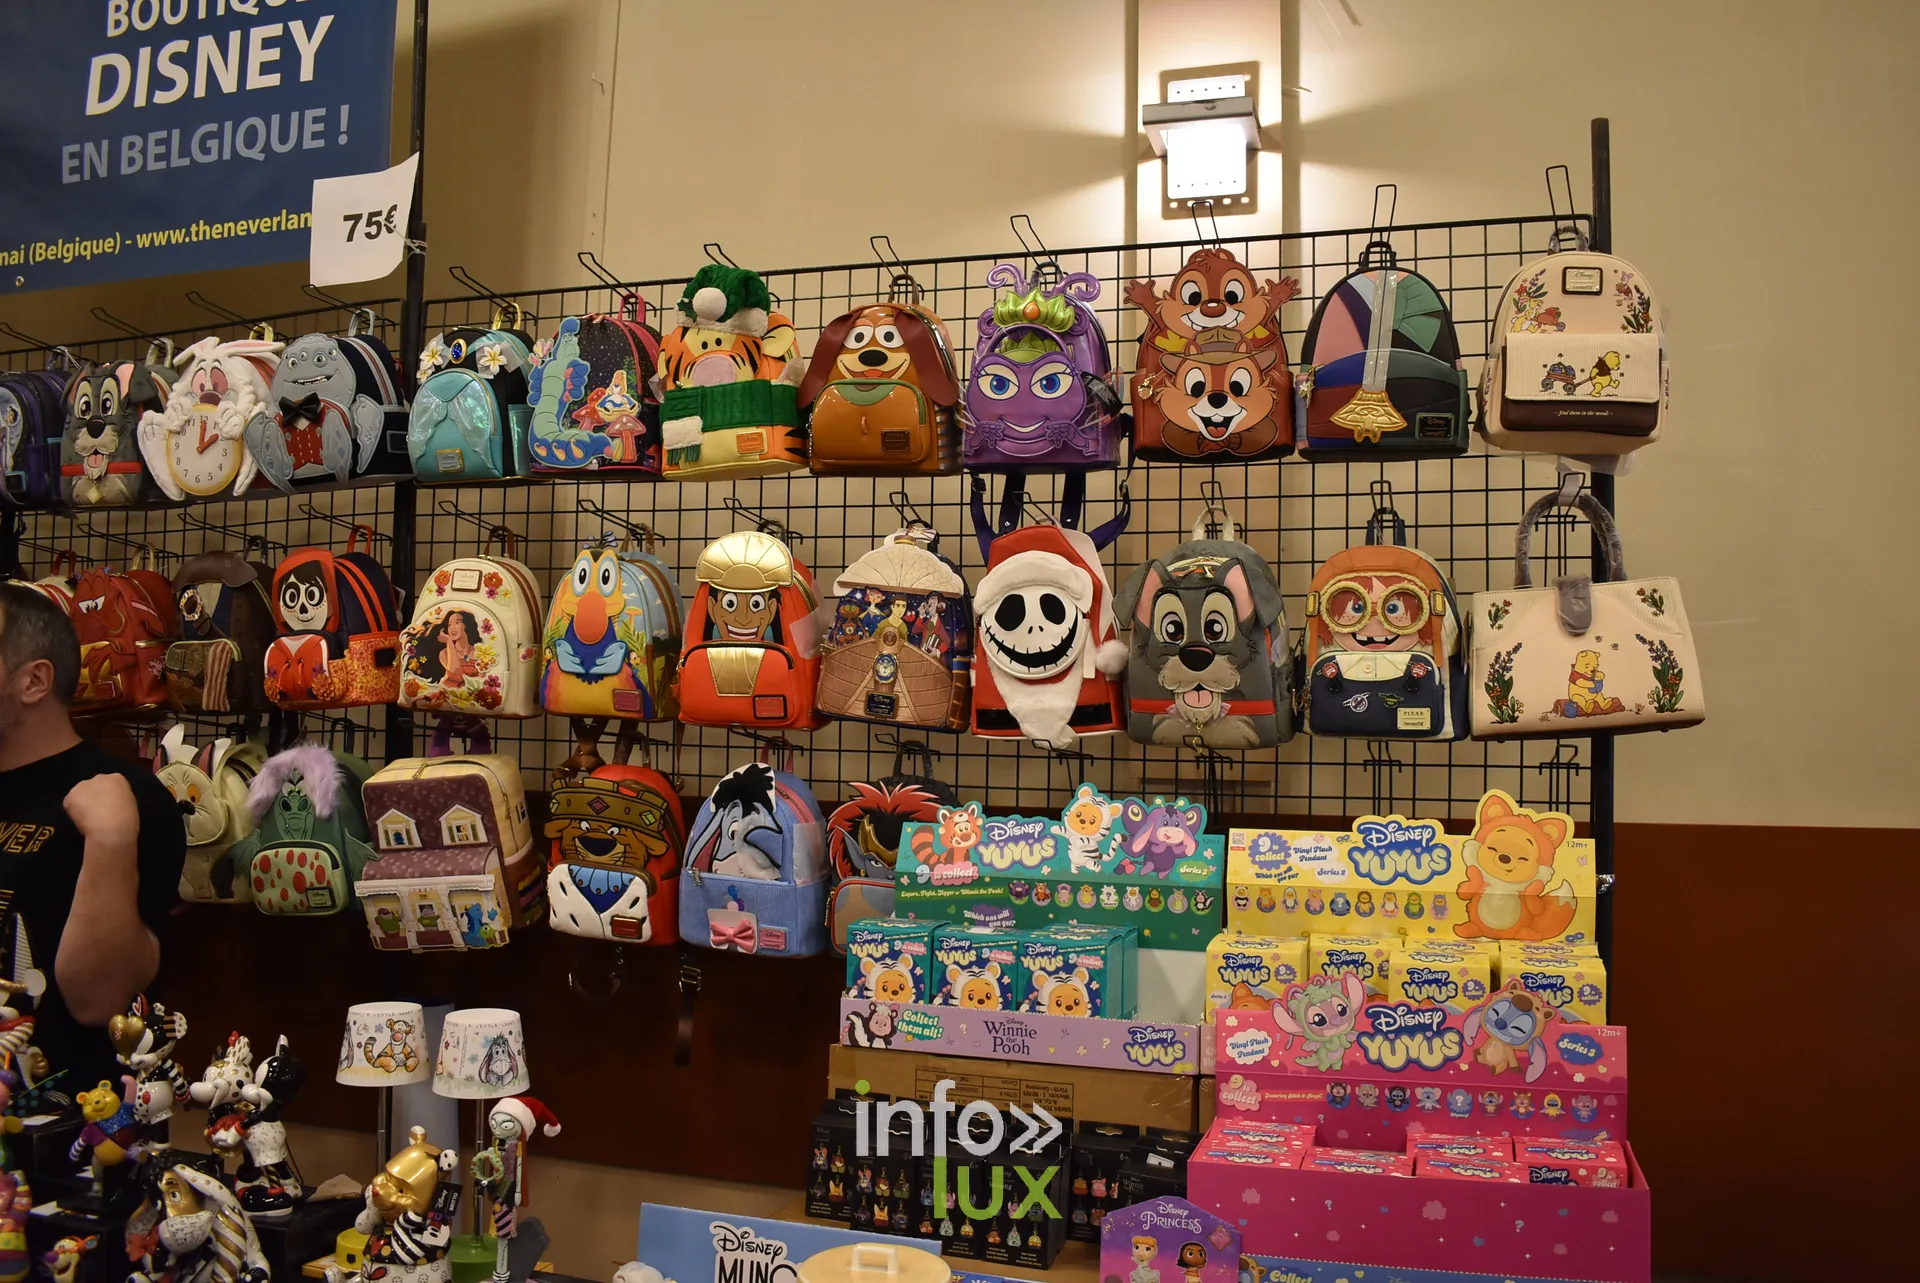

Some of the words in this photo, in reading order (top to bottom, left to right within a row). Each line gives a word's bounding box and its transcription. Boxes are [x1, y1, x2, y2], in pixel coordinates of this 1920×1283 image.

[85, 14, 335, 116] DISNEY
[61, 139, 109, 184] EN
[120, 107, 327, 175] BELGIQUE
[342, 204, 398, 243] 75€
[29, 231, 121, 265] (Belgique)
[174, 442, 180, 450] 9
[222, 448, 228, 457] 3
[176, 457, 181, 466] 8
[217, 463, 223, 471] 4
[184, 469, 188, 478] 7
[195, 475, 200, 483] 6
[207, 472, 213, 481] 5
[985, 820, 1044, 841] Disney
[1357, 823, 1433, 847] Disney
[1258, 836, 1271, 853] 9
[1293, 846, 1312, 855] Vinyl
[1313, 845, 1333, 853] Plush
[1566, 840, 1589, 849] 12m+
[1255, 852, 1285, 862] collect
[1299, 854, 1328, 862] Pendant
[1179, 866, 1201, 876] Series
[1317, 867, 1339, 876] Series
[1352, 847, 1449, 883] YUYUS
[916, 864, 931, 884] 9
[963, 909, 983, 921] Which
[998, 909, 1010, 919] will
[1223, 954, 1262, 967] Disney
[1327, 950, 1366, 963] Disney
[1279, 965, 1287, 974] 9
[1408, 968, 1448, 983] Disney
[1467, 982, 1475, 991] 9
[1521, 973, 1563, 988] Disney
[1583, 986, 1591, 996] 9
[903, 1010, 940, 1027] Collect
[1368, 1007, 1443, 1031] Disney
[898, 1020, 922, 1035] them
[923, 1026, 944, 1039] all!
[983, 1020, 1037, 1039] Winnie
[1129, 1027, 1175, 1044] Disney
[1597, 1029, 1622, 1037] 12m+
[992, 1037, 1030, 1056] Pooh
[1006, 1036, 1018, 1044] the
[1230, 1040, 1249, 1050] Vinyl
[1249, 1037, 1269, 1047] Plush
[1558, 1038, 1588, 1055] Series
[1237, 1048, 1265, 1058] Pendant
[1361, 1033, 1461, 1069] YUYUS
[1230, 1073, 1244, 1089] 9
[1243, 1084, 1251, 1092] to
[1222, 1090, 1257, 1105] collect
[1529, 1166, 1568, 1181] Disney
[1156, 1201, 1189, 1218] Disney
[713, 1225, 783, 1265] Disney
